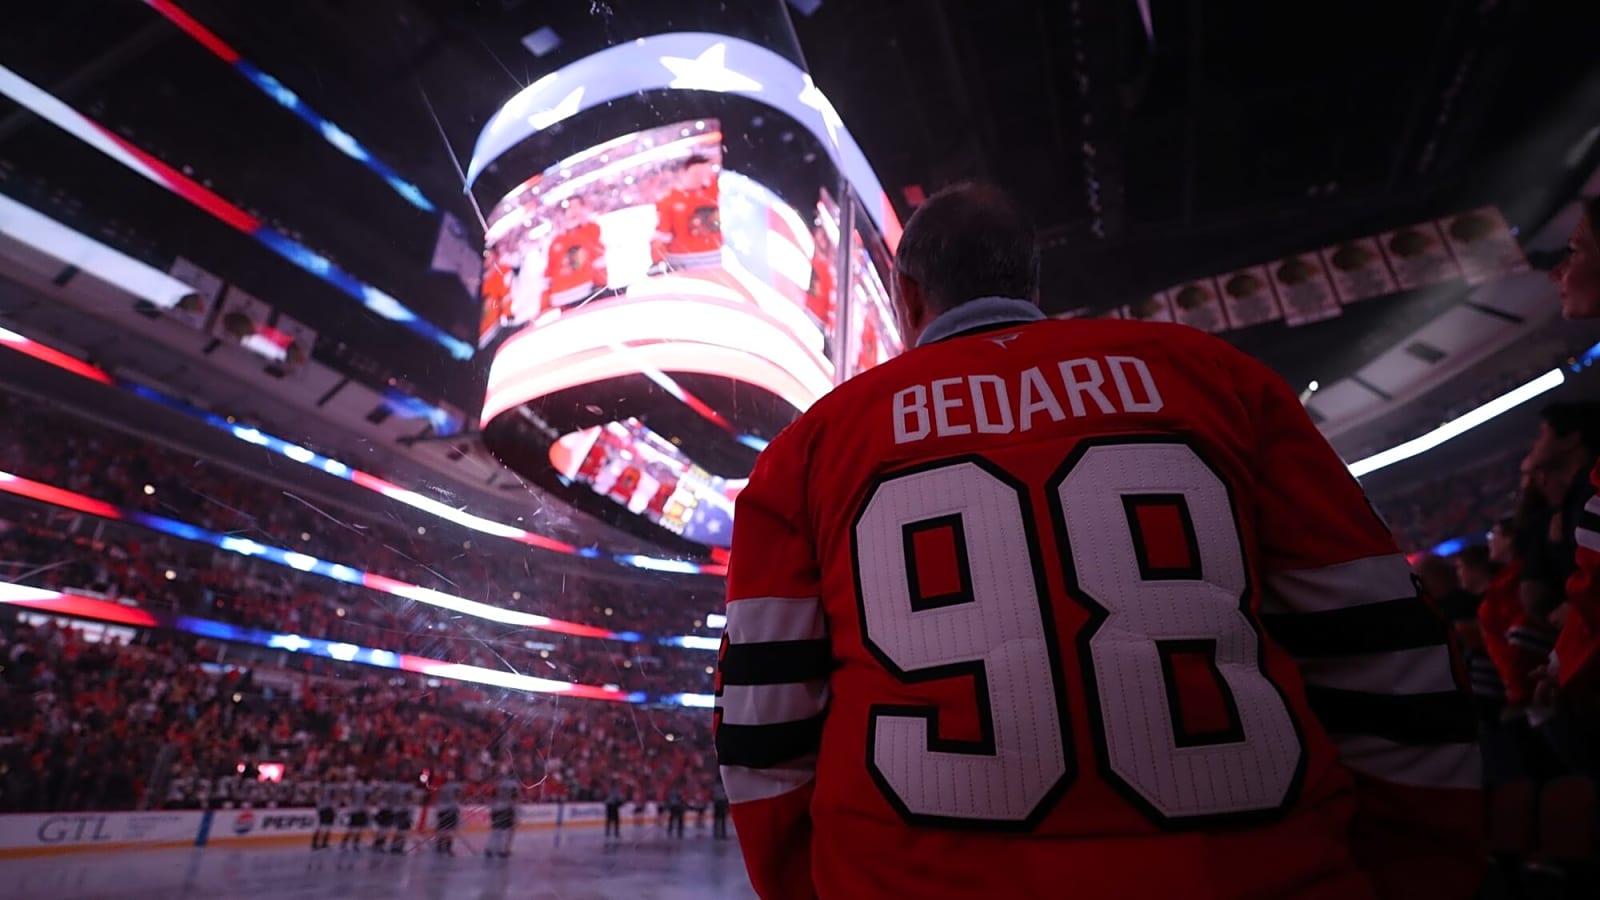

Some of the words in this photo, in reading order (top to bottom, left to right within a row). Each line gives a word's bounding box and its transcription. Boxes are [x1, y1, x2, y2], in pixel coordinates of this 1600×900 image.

[892, 355, 1164, 444] BEDARD
[853, 436, 1306, 828] 98
[37, 815, 111, 843] GTL
